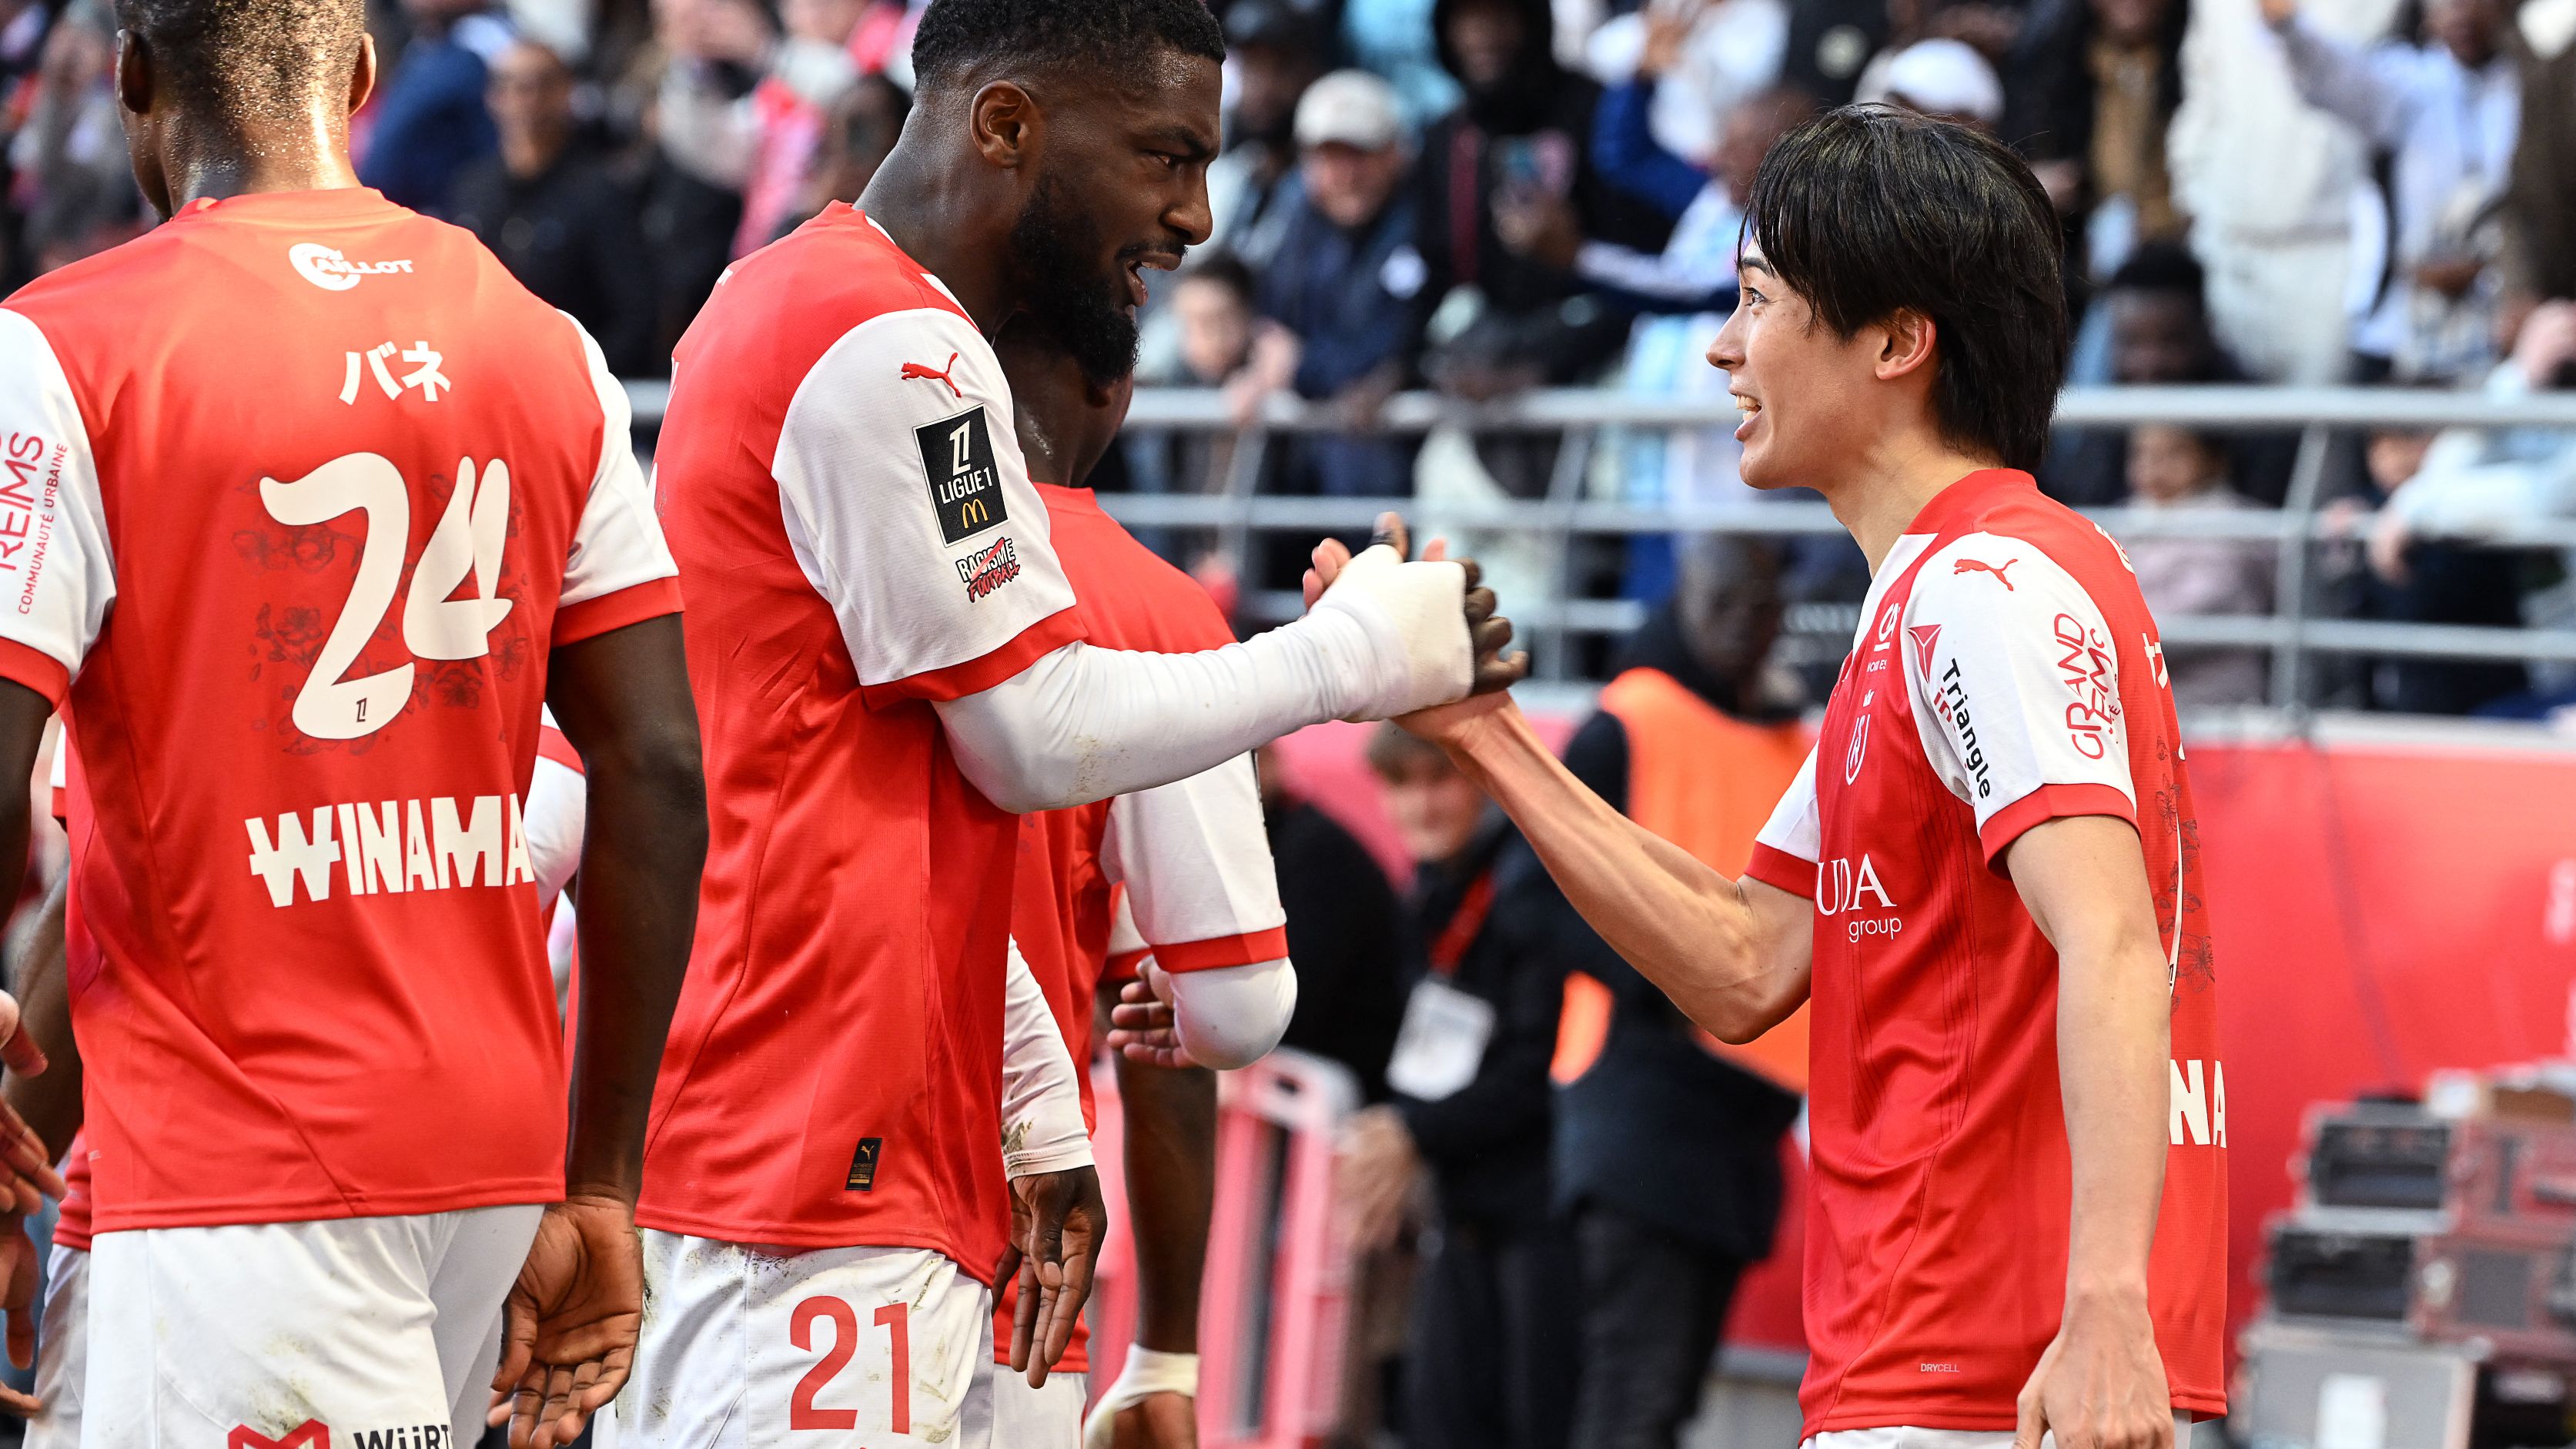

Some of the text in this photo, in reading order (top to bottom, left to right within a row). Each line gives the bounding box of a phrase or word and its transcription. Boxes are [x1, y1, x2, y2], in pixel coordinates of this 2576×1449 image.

[289, 243, 413, 291] CAILLOT
[338, 341, 451, 406] バネ
[939, 467, 993, 504] LIGUE 1
[18, 443, 69, 614] COMMUNAUTÉ URBAINE
[956, 537, 1015, 583] RACISME
[259, 452, 514, 739] 24
[968, 560, 1020, 603] FOOTBALL
[2054, 614, 2104, 760] GRAND
[1942, 658, 1990, 799] Triangle
[1816, 853, 1897, 916] UDA
[1848, 917, 1902, 943] group
[790, 1295, 910, 1434] 21
[1921, 1363, 1960, 1373] DRYCELL
